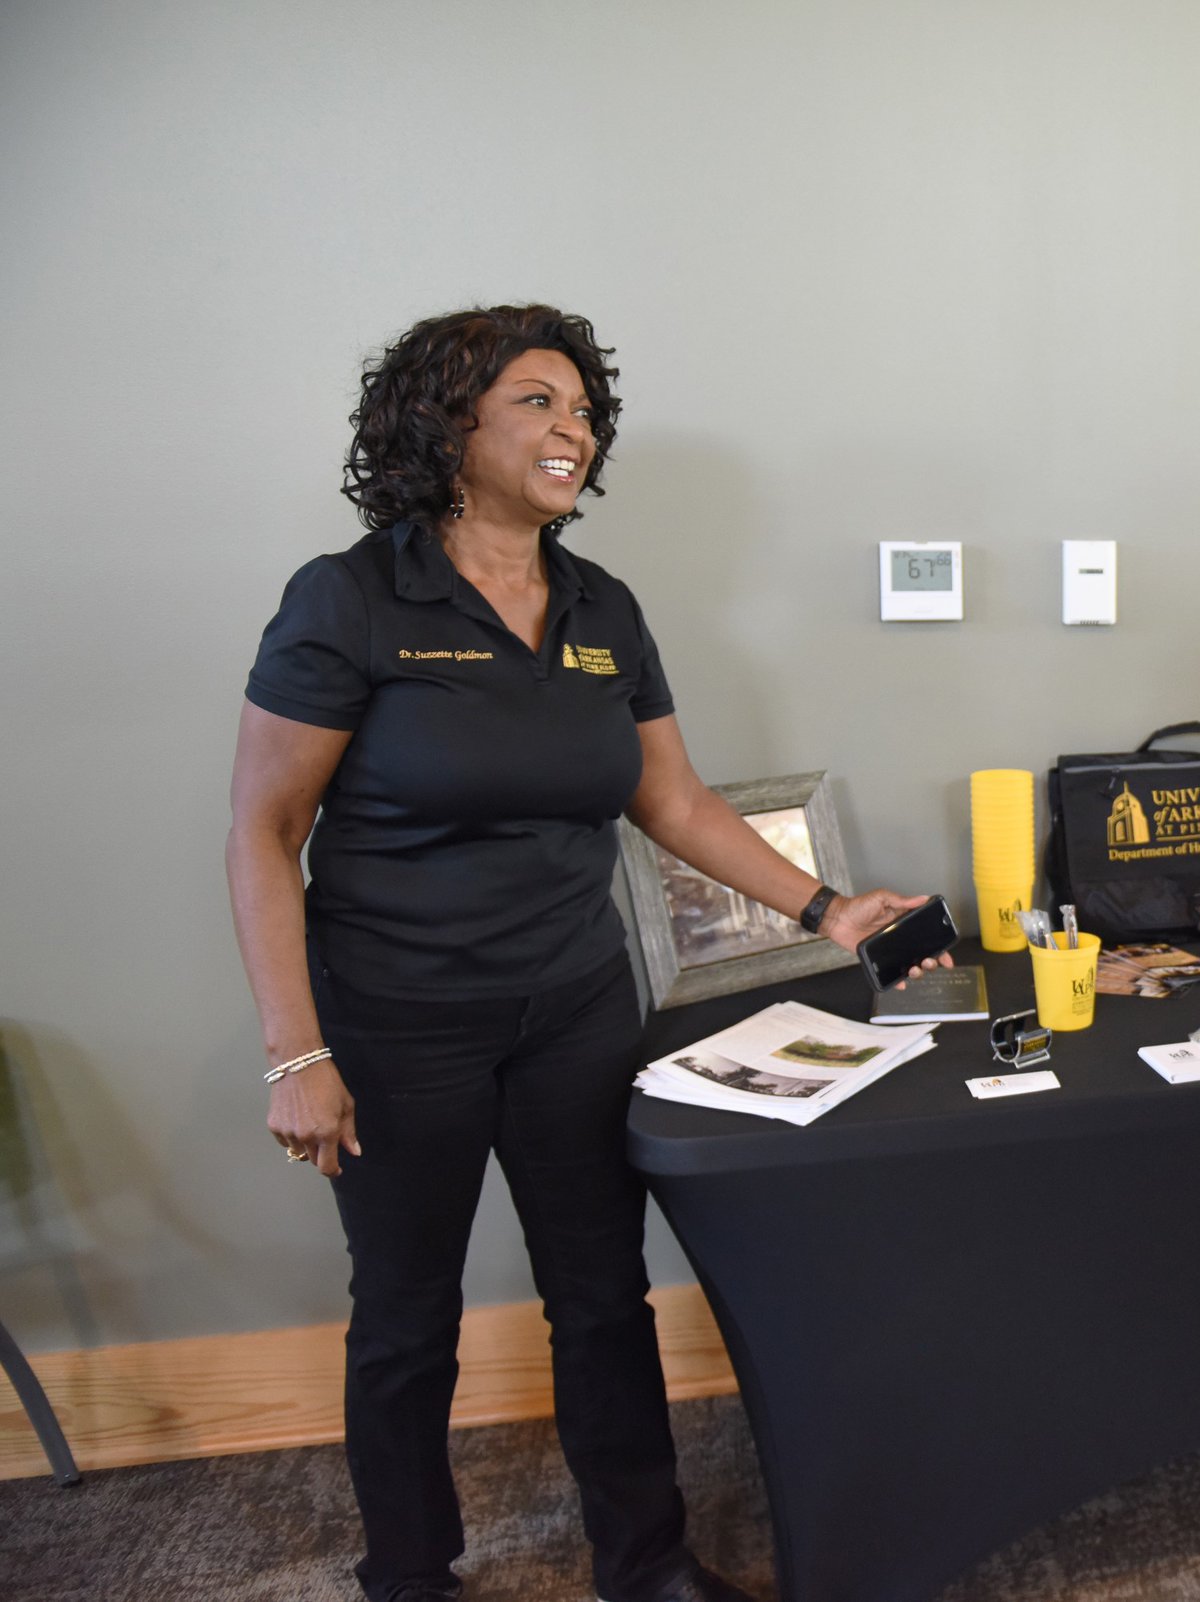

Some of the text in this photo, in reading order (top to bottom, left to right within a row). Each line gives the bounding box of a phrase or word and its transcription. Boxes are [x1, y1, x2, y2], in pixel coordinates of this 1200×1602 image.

[908, 558, 934, 579] 67
[399, 649, 414, 659] Dr.
[1153, 805, 1168, 825] of
[1155, 823, 1173, 835] AT
[1108, 845, 1173, 862] Department
[1175, 842, 1187, 855] of
